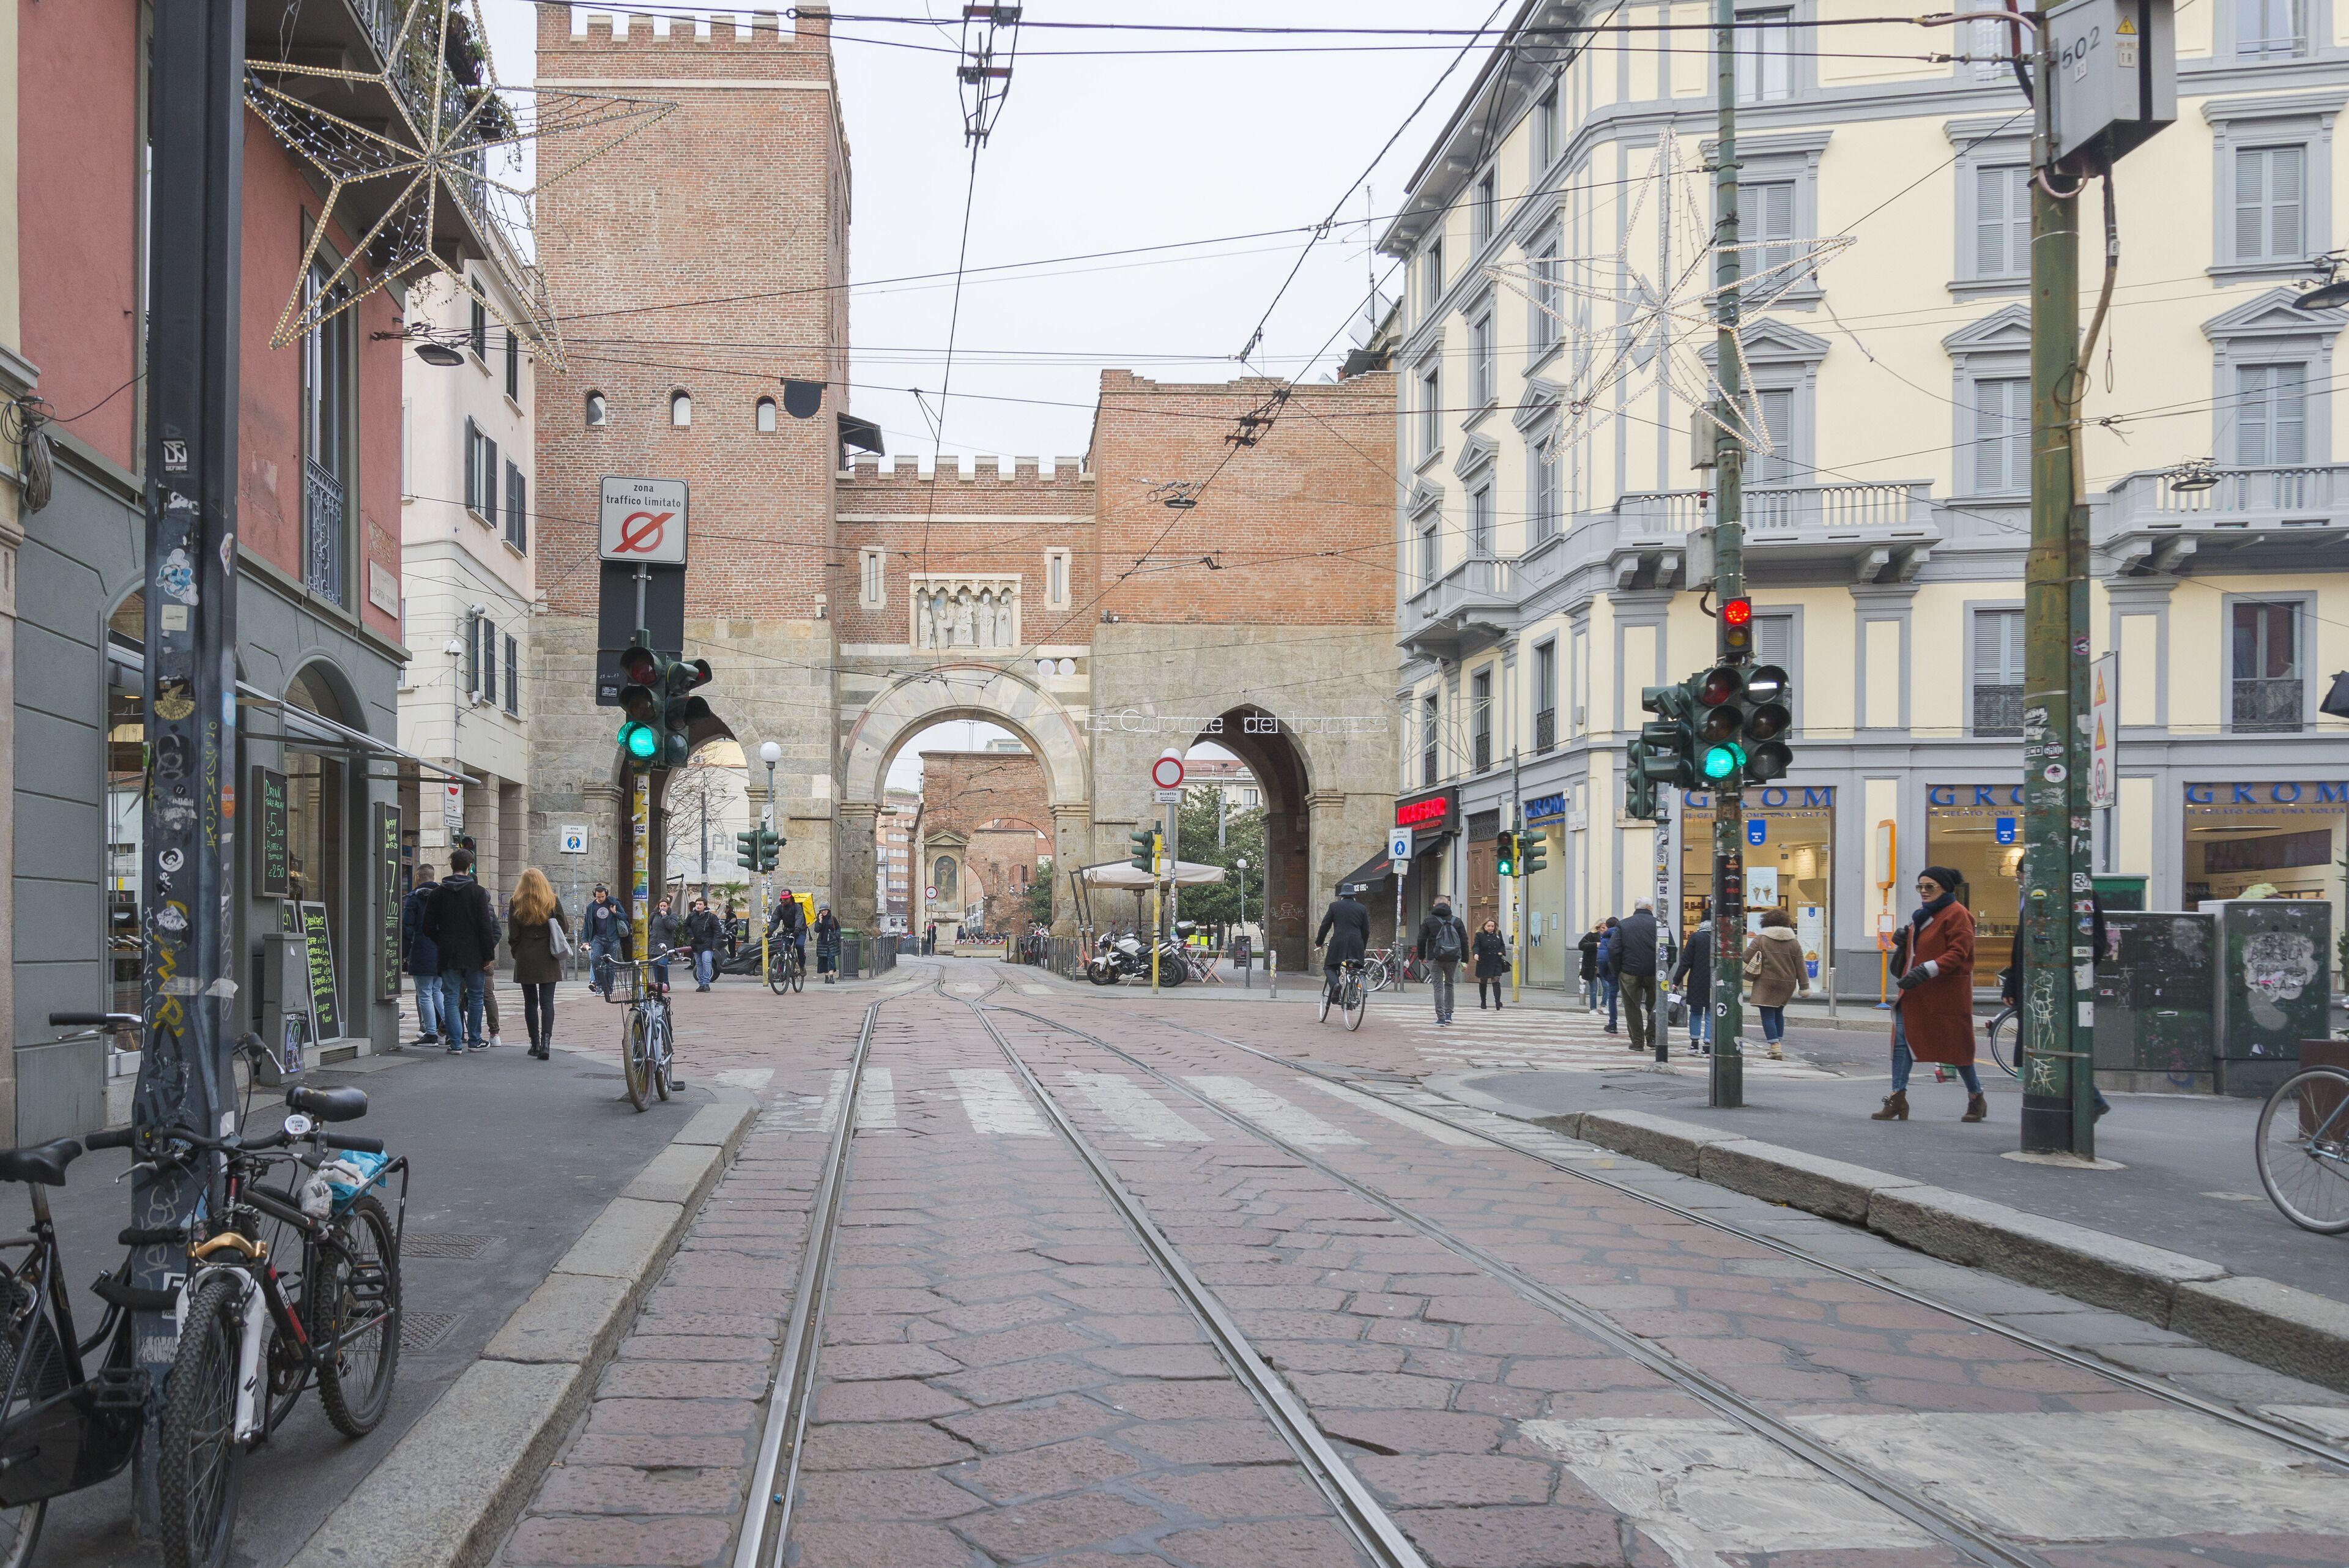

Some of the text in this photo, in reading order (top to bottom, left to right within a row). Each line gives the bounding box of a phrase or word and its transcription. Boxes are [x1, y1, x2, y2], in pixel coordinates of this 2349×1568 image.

[2062, 26, 2100, 70] 502
[606, 494, 681, 508] traffico limitato
[1085, 708, 1388, 734] Le Colonne del Ticinese
[265, 779, 282, 800] DRINK
[1684, 787, 1831, 807] GOM
[2186, 782, 2349, 803] GROM
[1525, 795, 1565, 819] GROM
